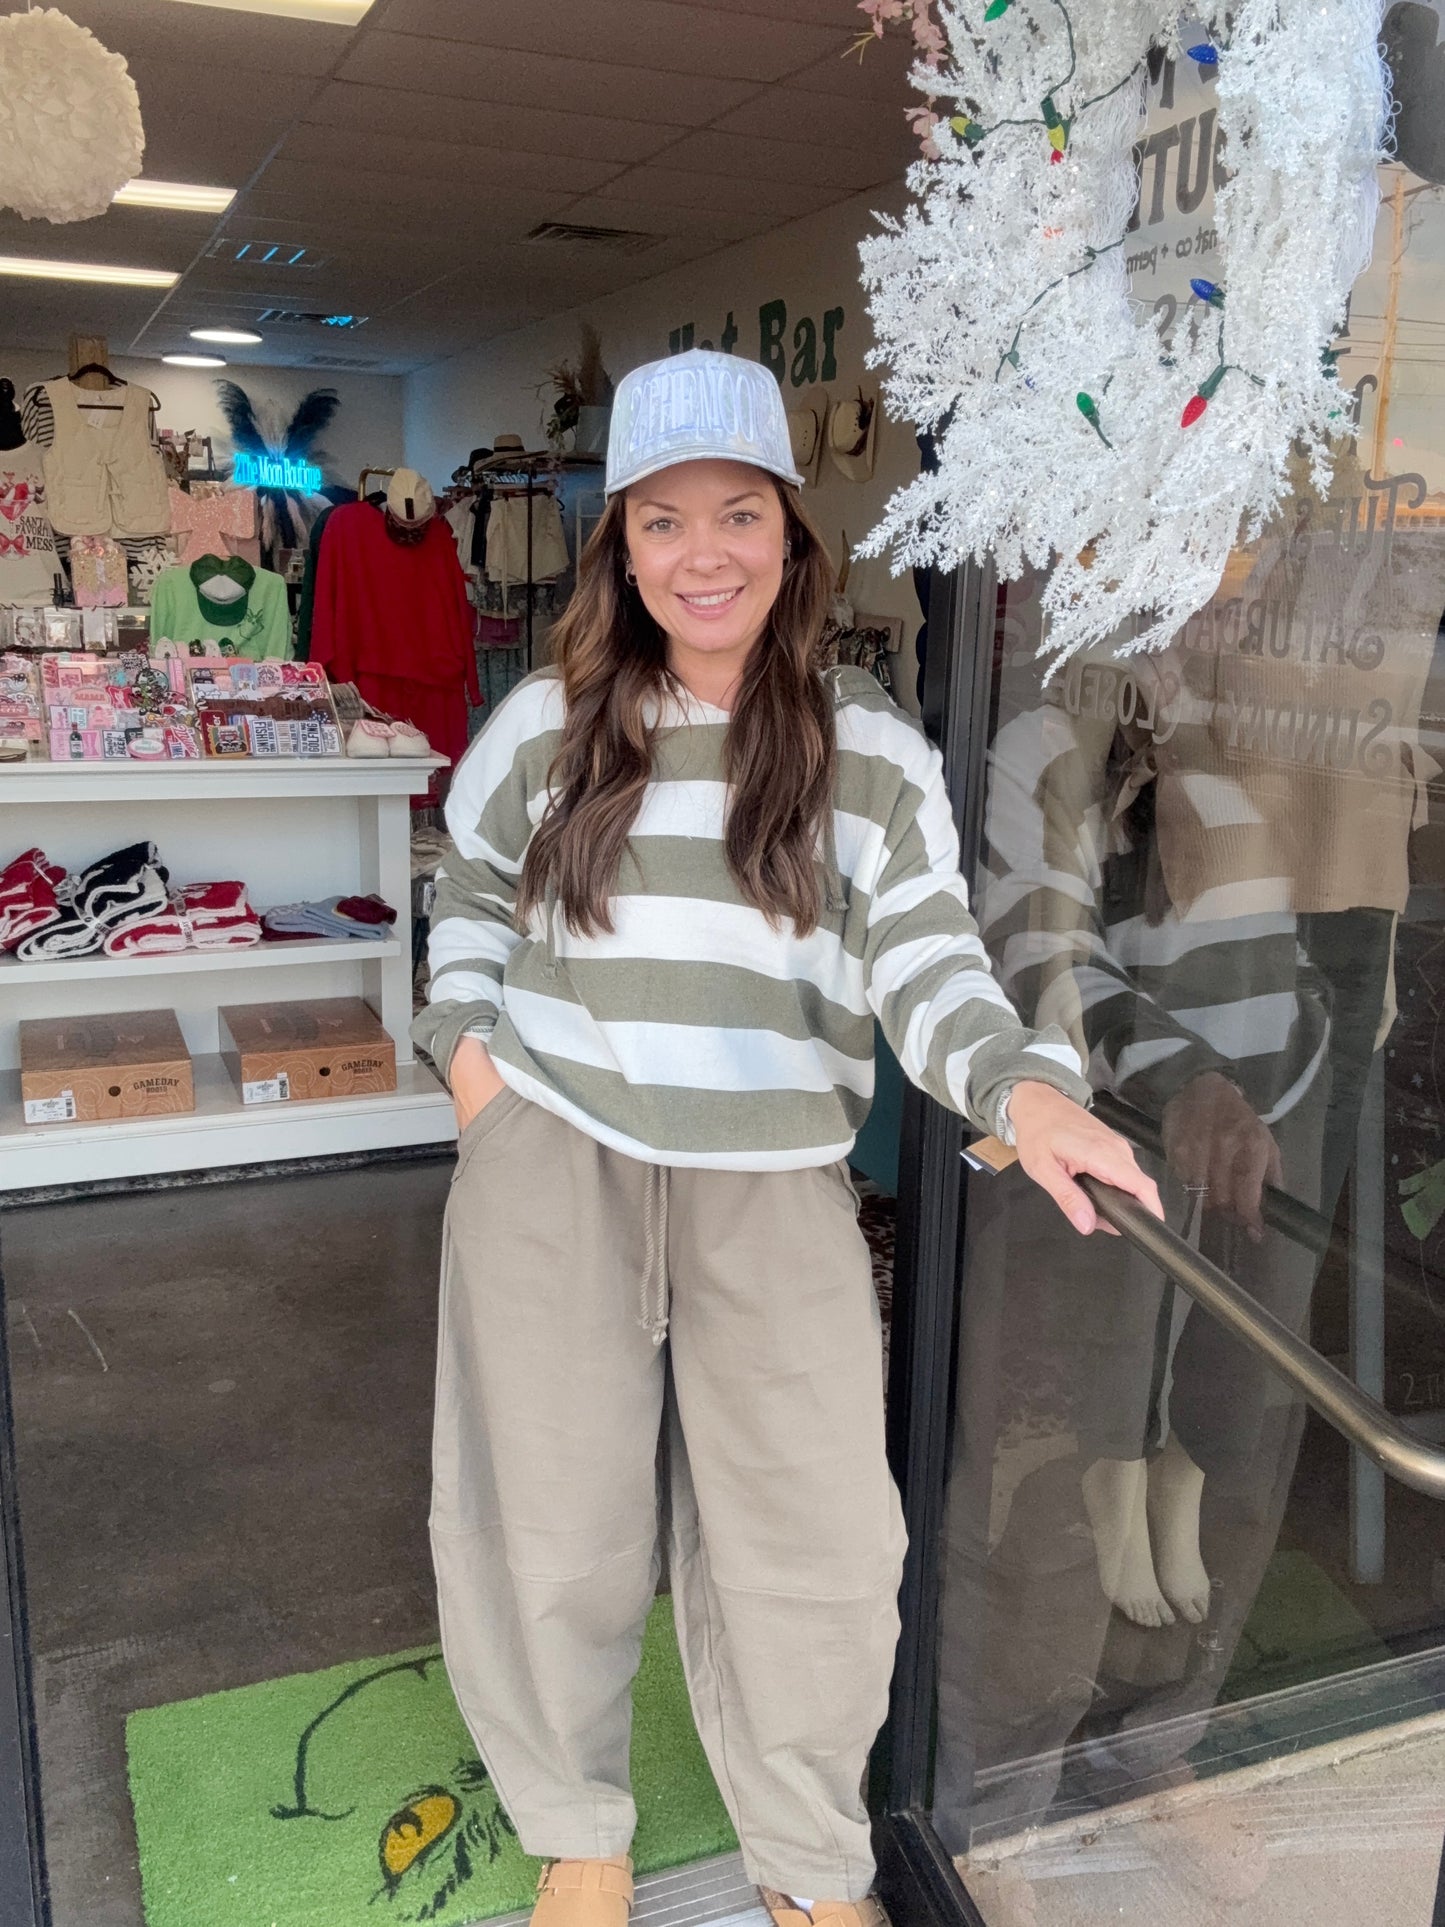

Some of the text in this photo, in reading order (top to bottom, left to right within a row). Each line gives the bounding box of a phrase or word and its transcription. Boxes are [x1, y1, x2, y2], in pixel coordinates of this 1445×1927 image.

[759, 299, 844, 388] Bar
[257, 455, 284, 487] Moon
[283, 458, 322, 497] Boutique
[26, 535, 54, 552] MESS
[254, 721, 269, 753] FISHING
[306, 723, 320, 753] GOLFING
[341, 1059, 384, 1072] GAMEDAY
[133, 1078, 180, 1091] GAMEDAY
